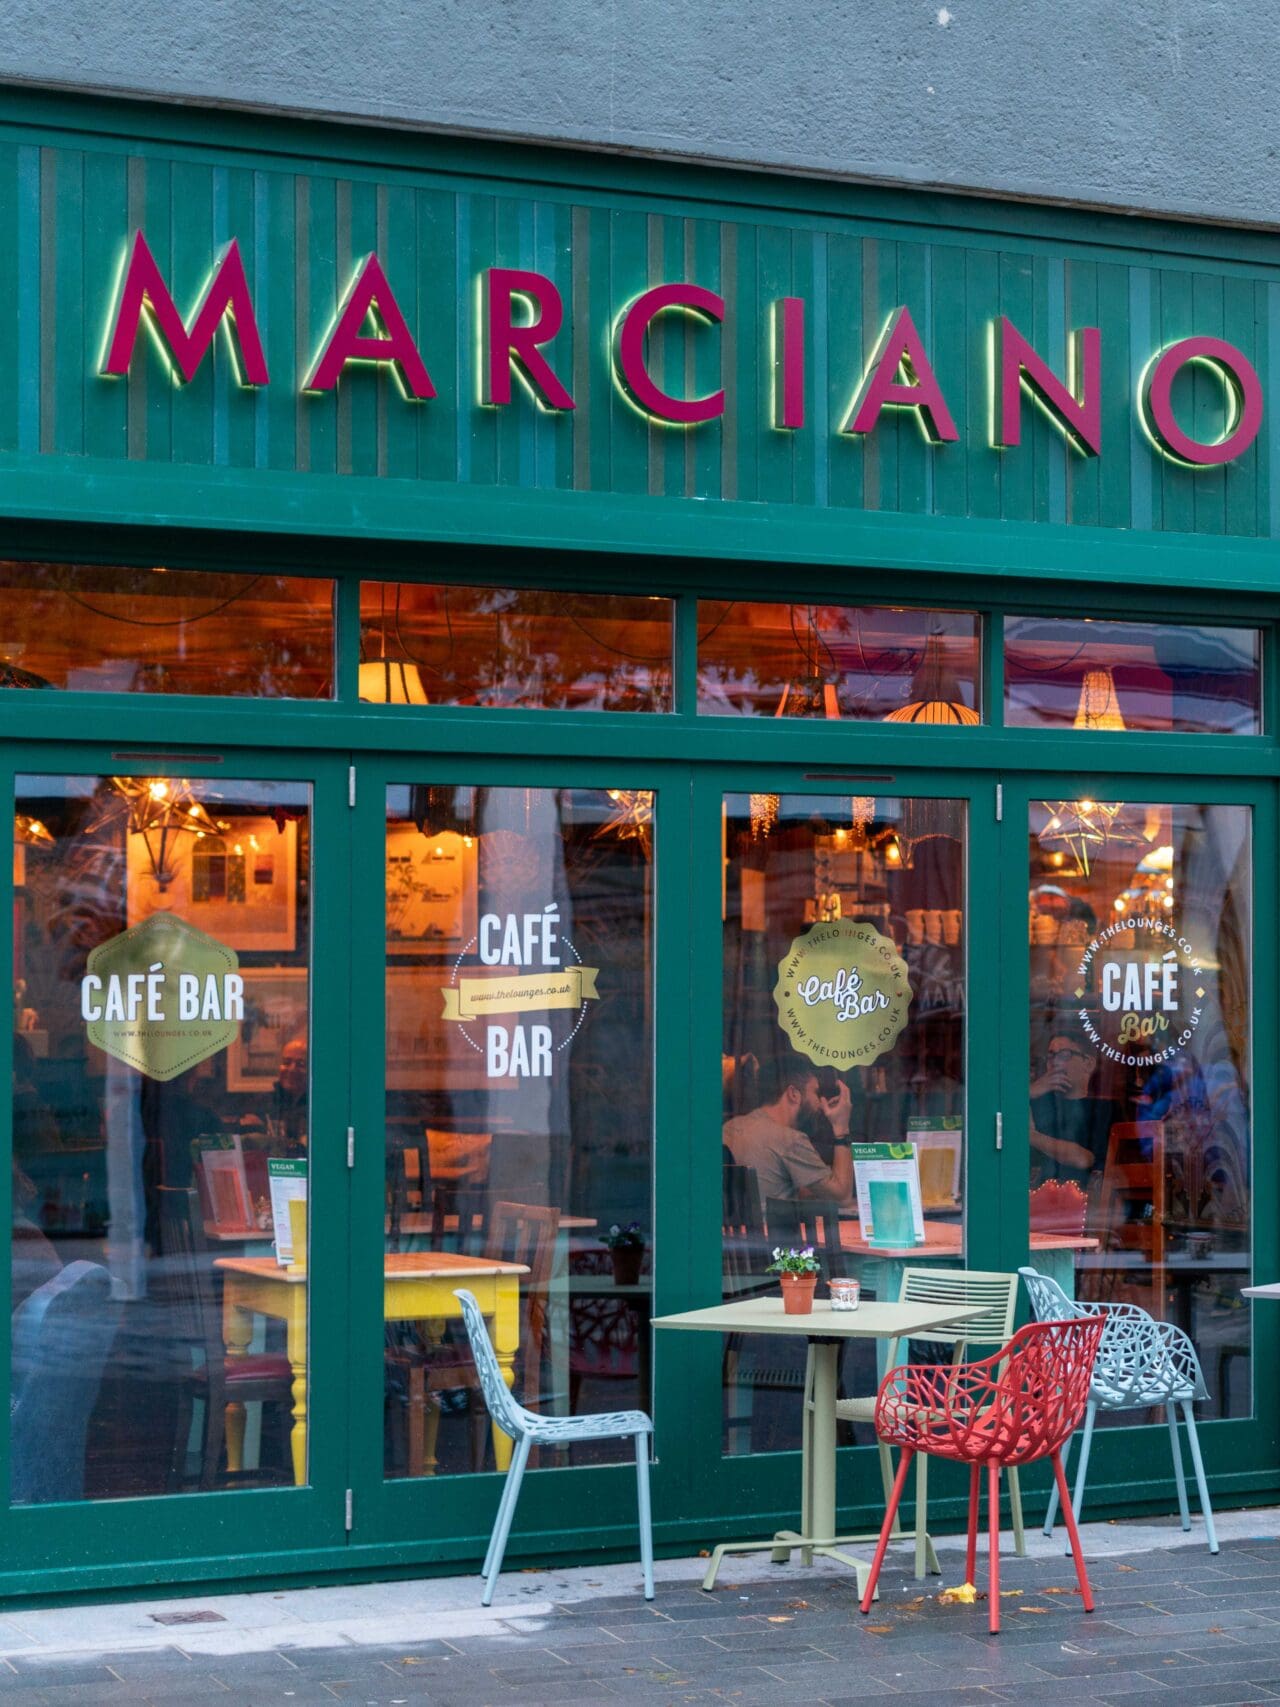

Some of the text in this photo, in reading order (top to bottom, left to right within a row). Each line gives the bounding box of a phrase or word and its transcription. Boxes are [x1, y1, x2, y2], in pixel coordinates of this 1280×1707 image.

[99, 228, 1263, 467] MARCIANO
[480, 902, 560, 966] CAFÉ
[1077, 917, 1203, 976] WWW.THELOUNGES.CO.UK
[81, 961, 244, 1021] CAFÉ BAR
[470, 984, 572, 1002] www.thelounges.co.uk
[797, 967, 863, 1006] Café
[836, 989, 889, 1022] Bar
[1102, 949, 1178, 1012] CAFÉ
[487, 1025, 553, 1078] BAR
[786, 1007, 900, 1060] WWW.THELOUNGES.CO.UK
[1077, 1006, 1203, 1067] WWW.THELOUNGES.CO.UK
[1117, 1011, 1170, 1045] Bar
